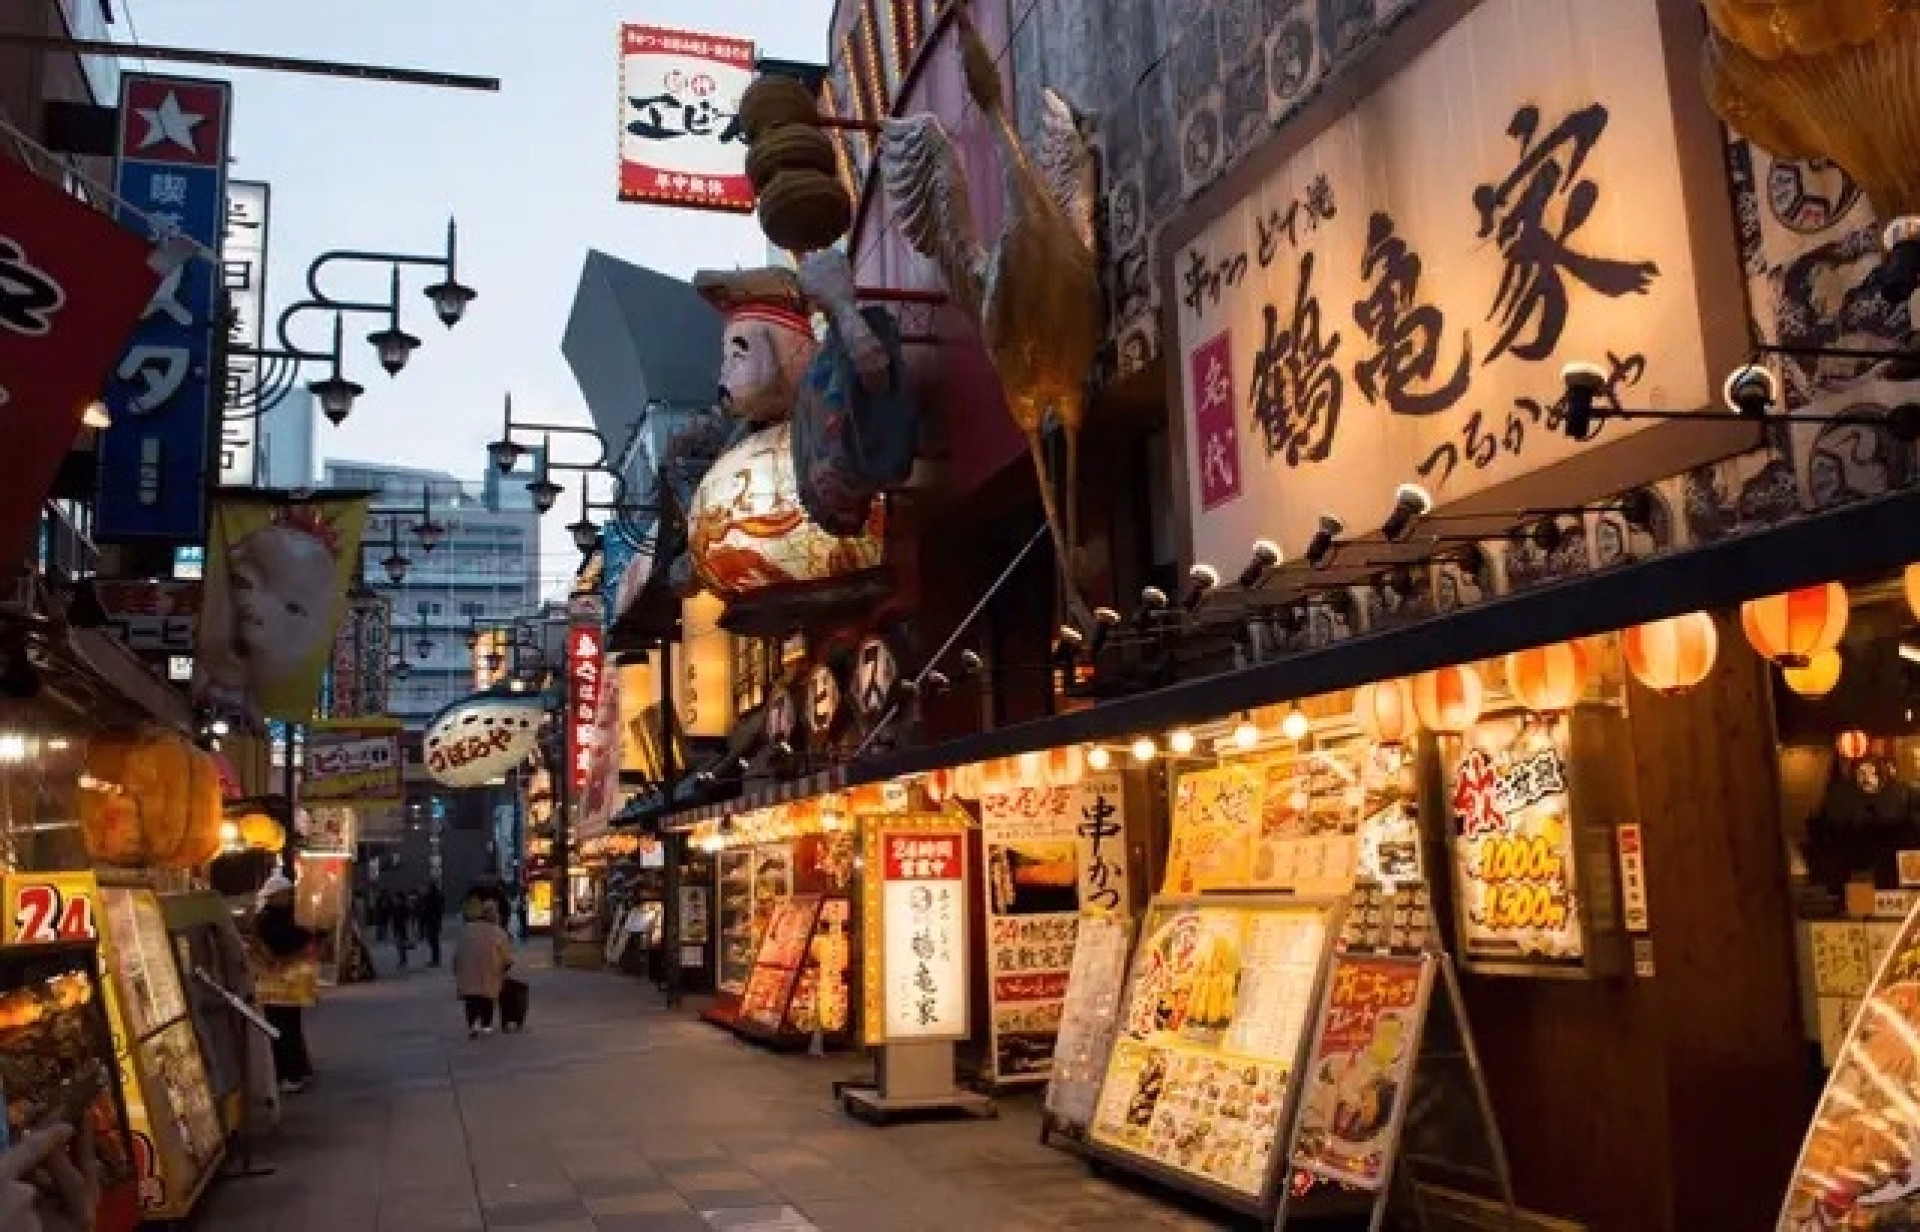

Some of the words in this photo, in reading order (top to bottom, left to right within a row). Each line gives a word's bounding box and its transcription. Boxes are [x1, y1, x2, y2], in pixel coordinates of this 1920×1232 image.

[1250, 102, 1661, 469] 鶴亀家
[1076, 795, 1123, 911] 串かつ
